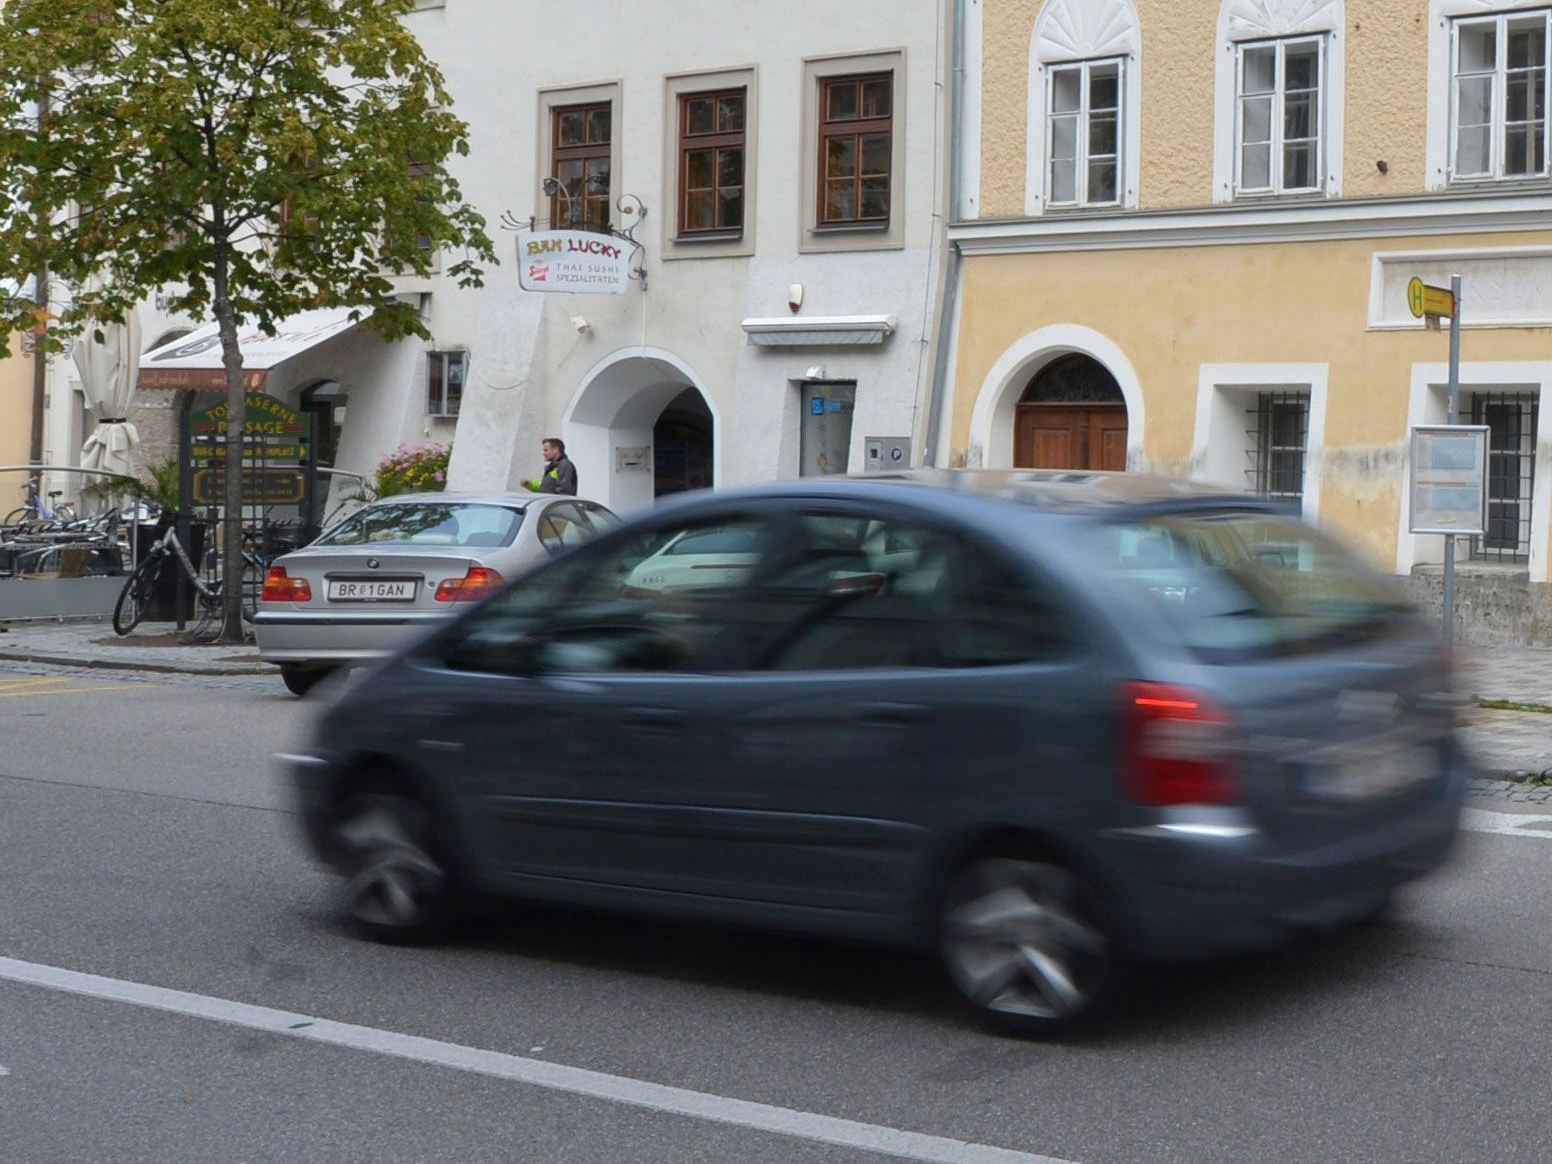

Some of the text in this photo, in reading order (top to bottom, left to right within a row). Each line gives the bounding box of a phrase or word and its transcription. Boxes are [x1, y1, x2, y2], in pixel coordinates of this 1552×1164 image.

[567, 239, 622, 259] LUCKY
[556, 263, 619, 274] THAI SUSHI
[217, 421, 284, 434] PSAGE
[339, 584, 357, 596] BR
